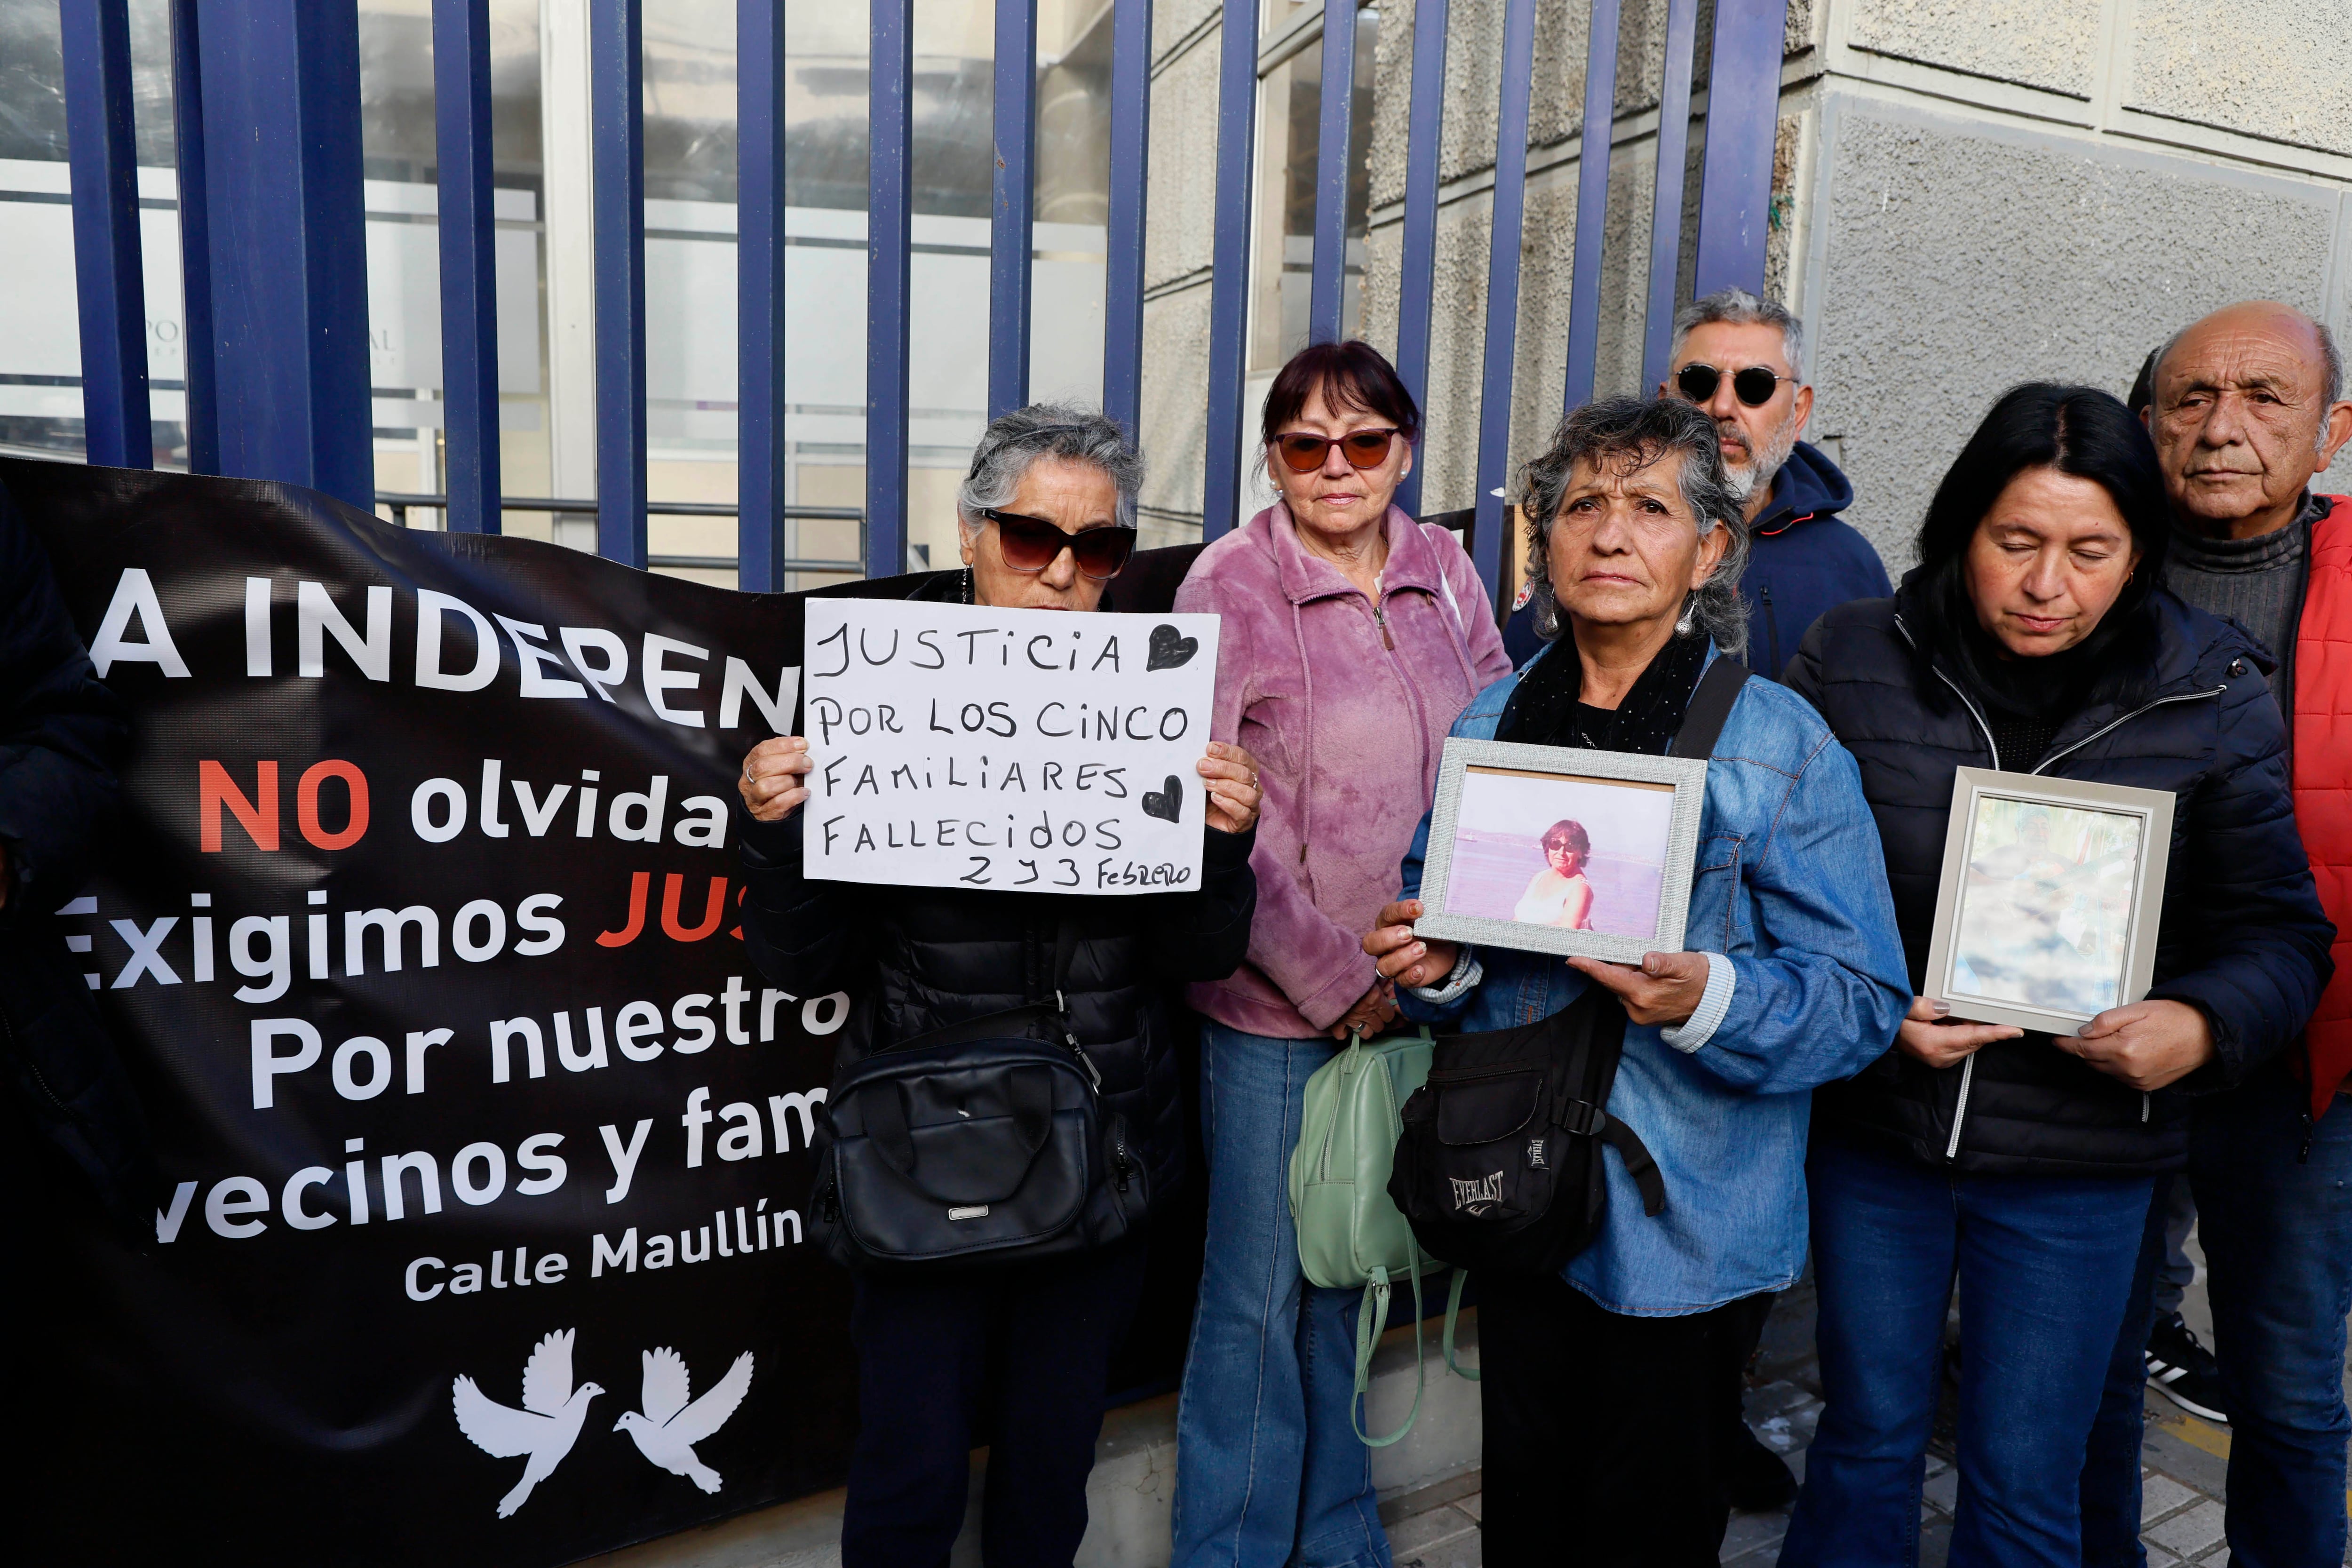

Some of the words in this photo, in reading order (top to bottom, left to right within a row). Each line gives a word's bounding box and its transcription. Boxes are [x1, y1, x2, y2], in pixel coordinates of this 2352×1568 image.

[88, 568, 192, 678] A
[810, 697, 904, 746] POR
[930, 698, 1017, 738] LOS
[200, 759, 370, 852] NO
[411, 758, 728, 849] olvida
[596, 872, 747, 947] JU
[960, 856, 992, 884] 2
[1052, 859, 1080, 886] 3
[251, 1019, 455, 1109] Por
[156, 1131, 567, 1243] vecinos
[598, 1118, 653, 1204] y
[1449, 1170, 1503, 1210] EVERLAST
[1532, 1139, 1545, 1165] EVERLAST
[405, 1247, 568, 1302] Calle
[591, 1198, 803, 1278] Maullín
